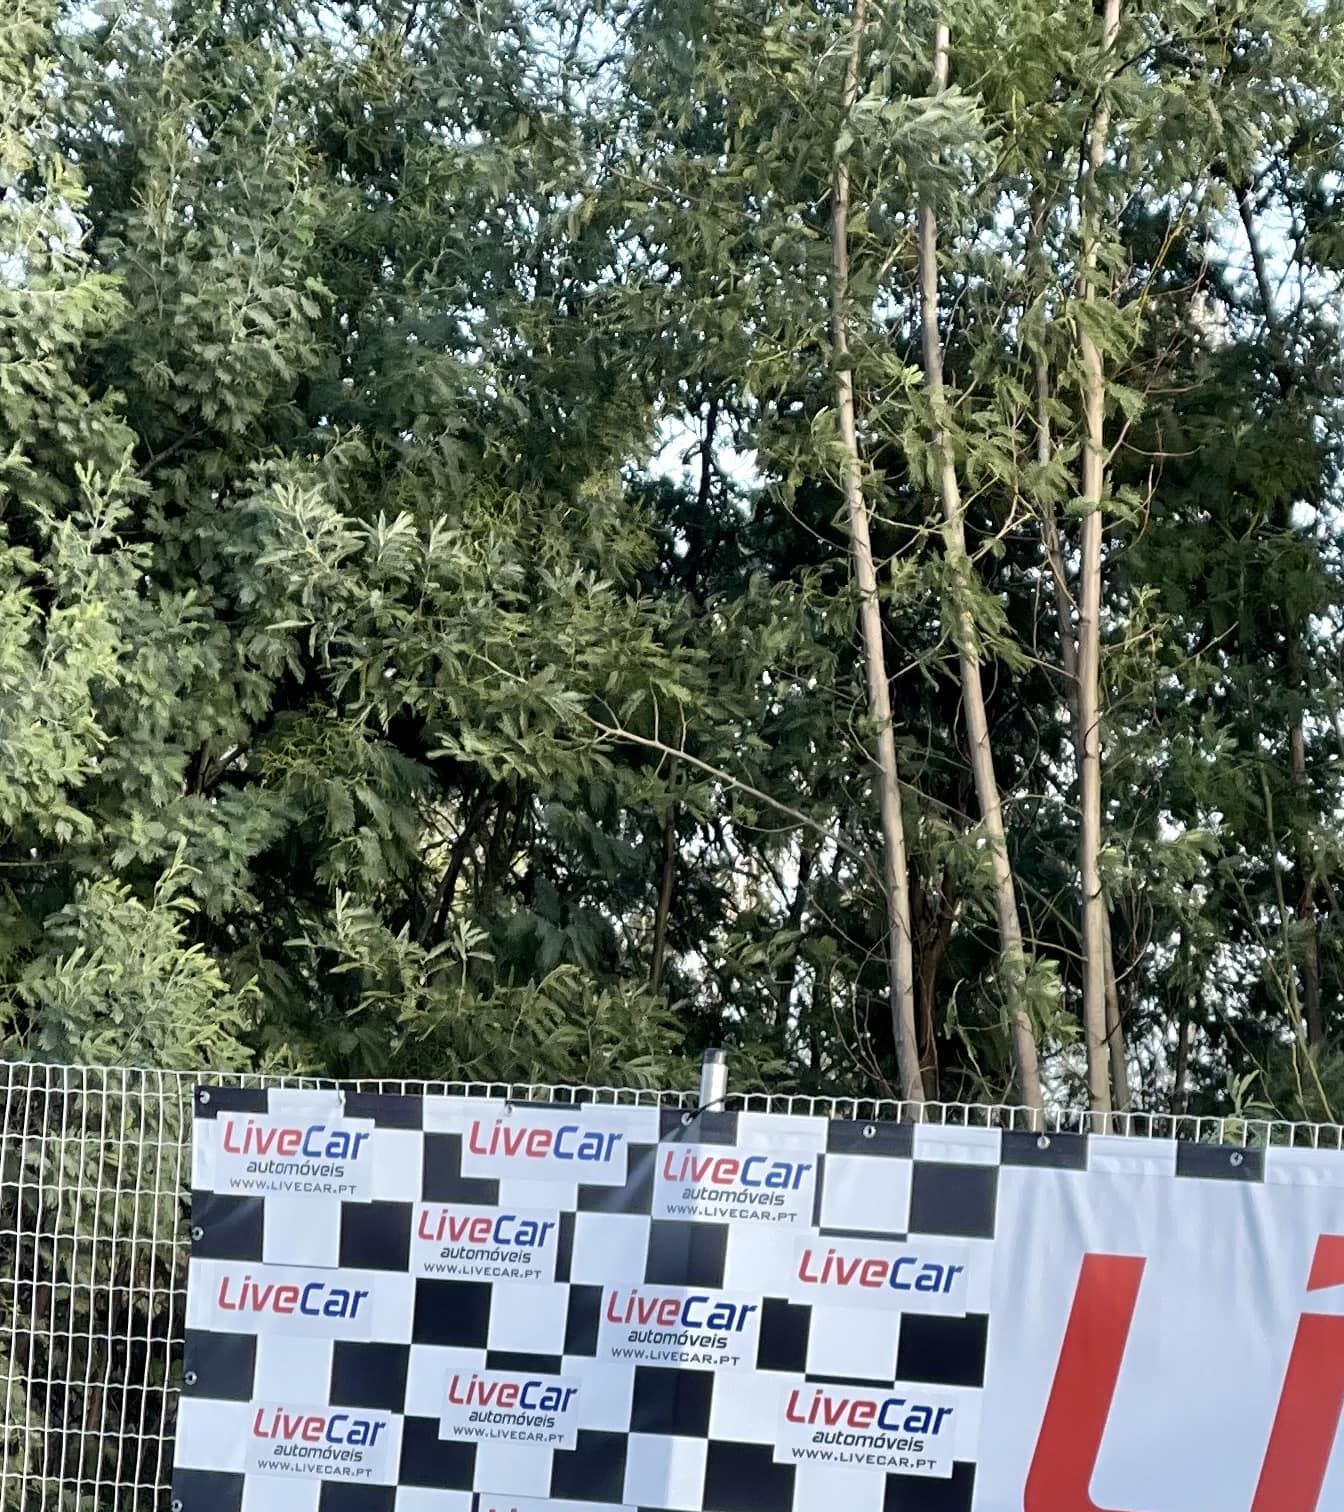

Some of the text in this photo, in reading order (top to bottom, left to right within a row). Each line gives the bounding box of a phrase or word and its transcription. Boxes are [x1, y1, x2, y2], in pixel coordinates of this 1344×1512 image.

[223, 1119, 371, 1160] LiveCar
[468, 1119, 624, 1162] LiveCar
[246, 1160, 344, 1178] automóveis
[662, 1148, 812, 1190] LiveCar
[229, 1177, 357, 1196] WWW.LIVECAR.PT
[682, 1186, 785, 1207] automóveis
[666, 1203, 798, 1223] WWW.LIVECAR.PT
[417, 1207, 556, 1248] LiveCar
[440, 1246, 532, 1264] automóveis
[423, 1262, 542, 1280] WWW.LIVECAR.PT
[797, 1248, 964, 1294] LiveCar
[218, 1274, 369, 1319] LiveCar
[605, 1288, 758, 1332] LiveCar
[627, 1328, 728, 1349] automóveis
[611, 1346, 741, 1366] WWW.LIVECAR.PT
[448, 1373, 578, 1413] LiveCar
[468, 1410, 556, 1428] automóveis
[785, 1388, 954, 1436] LiveCar
[252, 1407, 386, 1447] LiveCar
[453, 1425, 565, 1444] WWW.LIVECAR.PT
[811, 1429, 925, 1453] automóveis
[273, 1442, 363, 1463] automóveis
[791, 1447, 938, 1470] WWW.LIVECAR.PT
[257, 1459, 373, 1478] WWW.LIVECAR.PT
